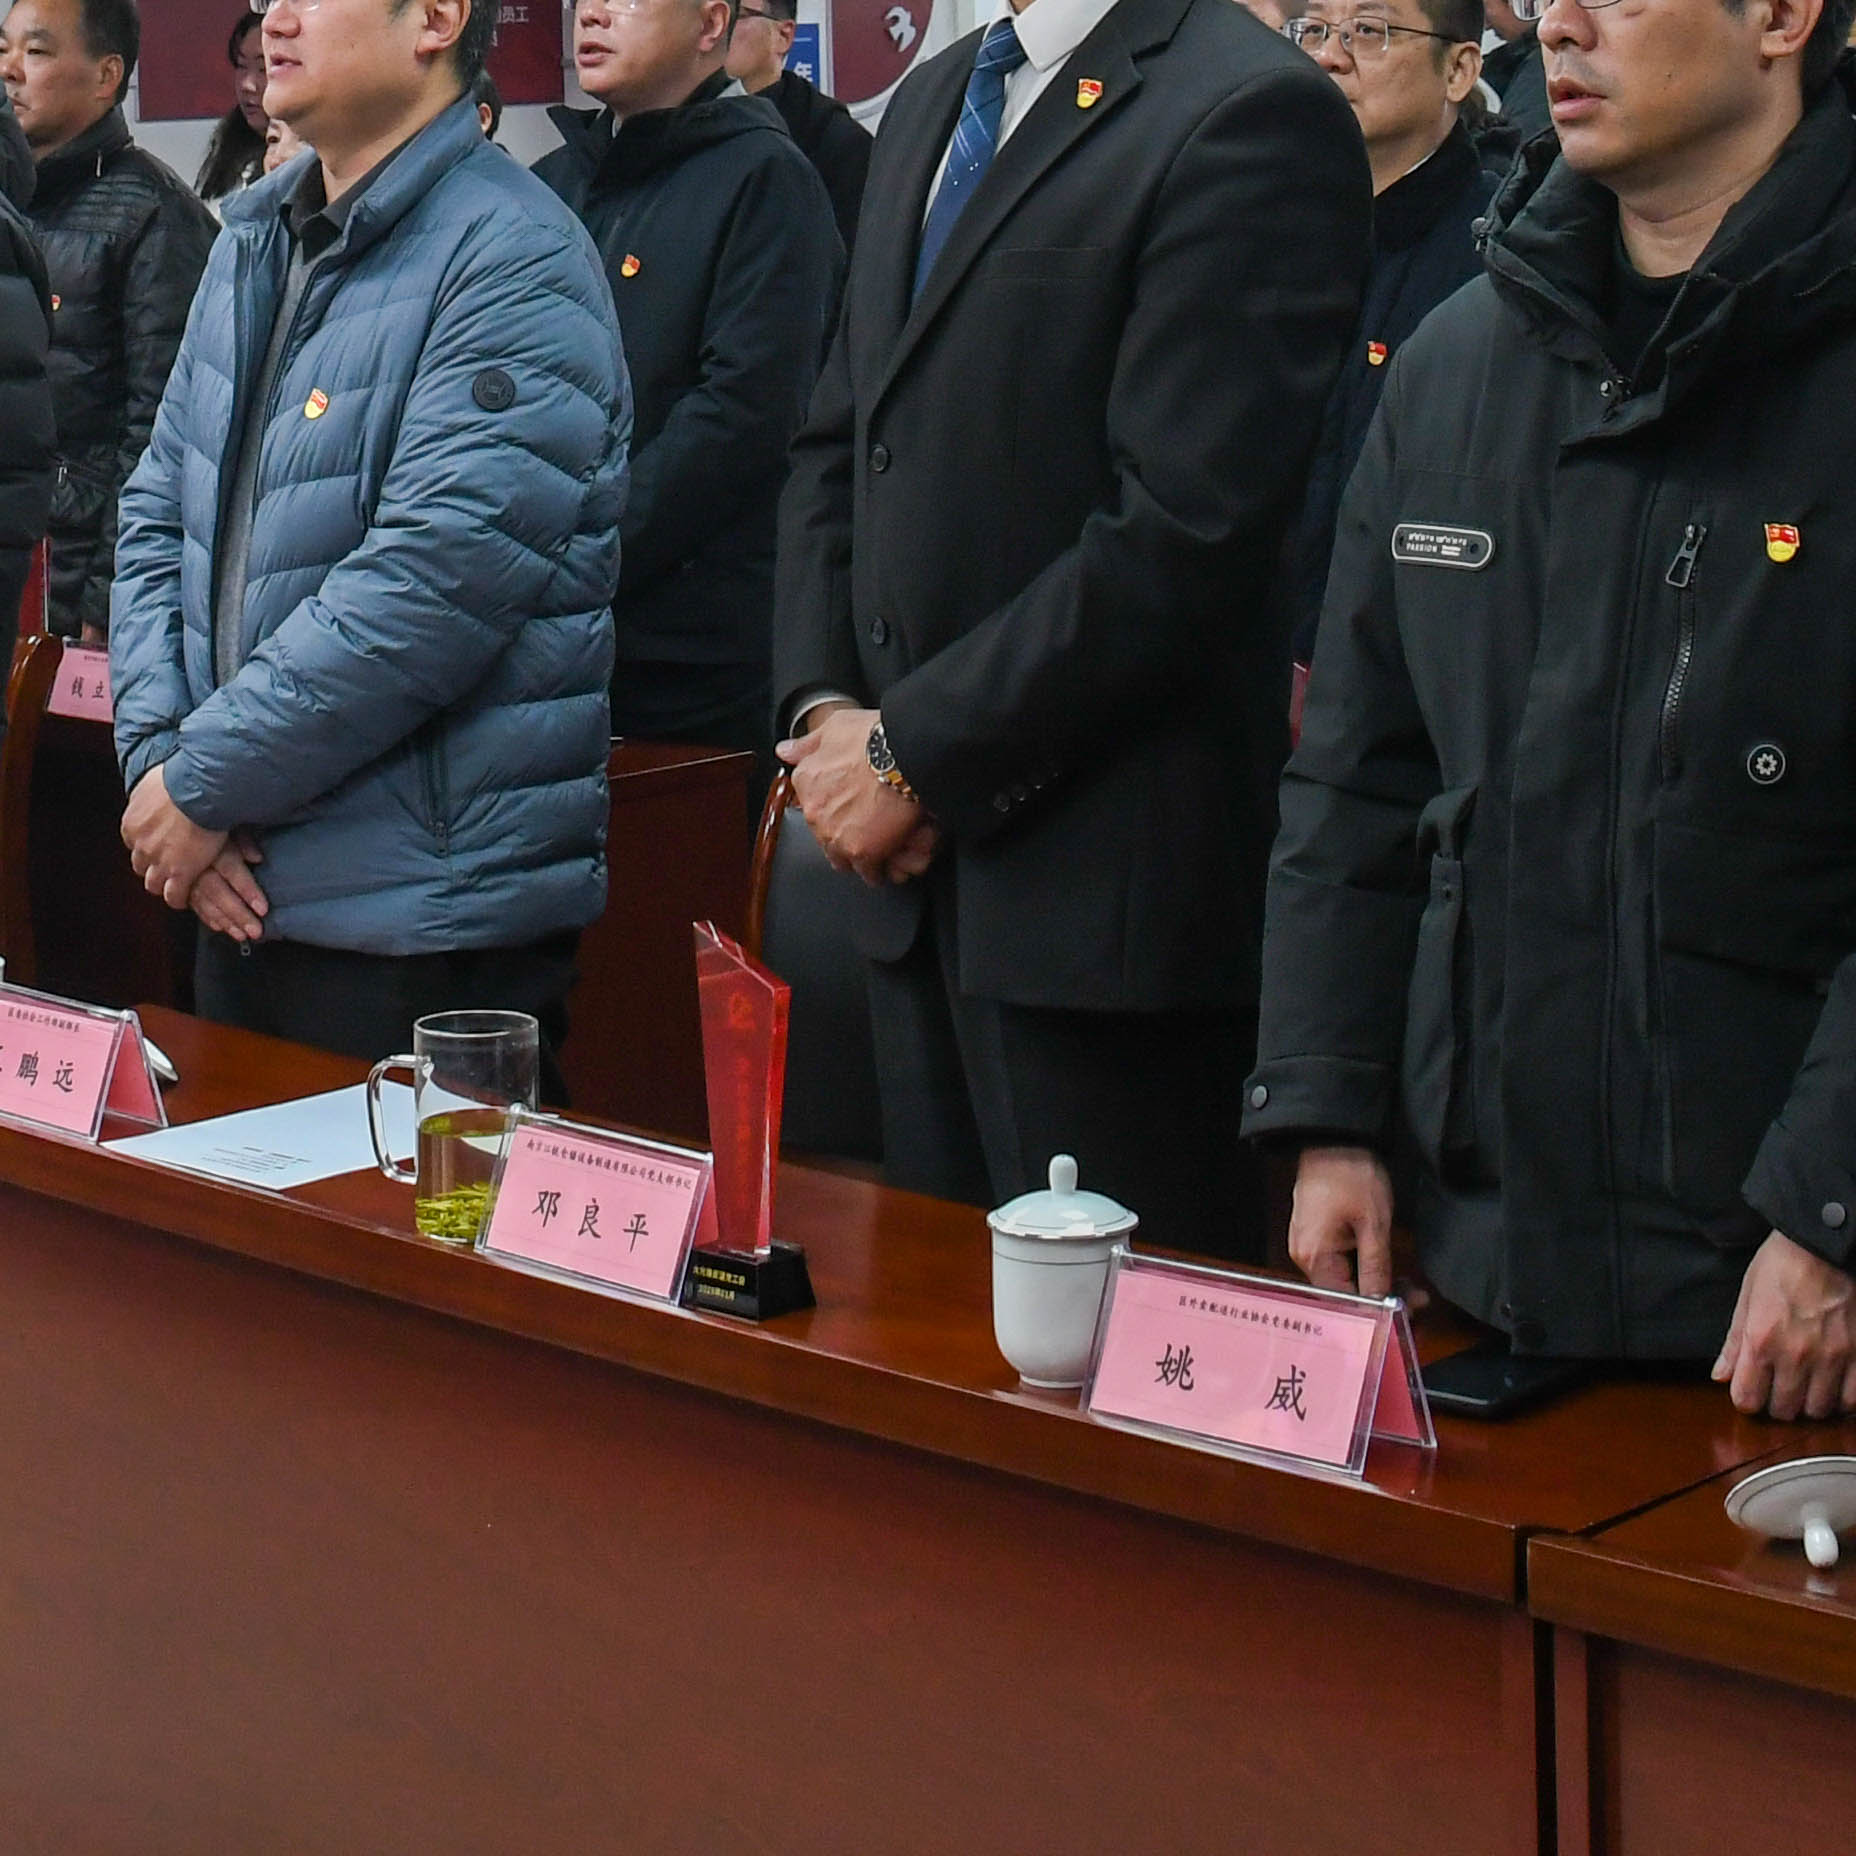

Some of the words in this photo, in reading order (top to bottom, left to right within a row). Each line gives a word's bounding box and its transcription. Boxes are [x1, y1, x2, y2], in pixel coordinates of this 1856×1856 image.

[532, 1190, 649, 1253] 邓良平
[1154, 1343, 1309, 1422] 姚威
